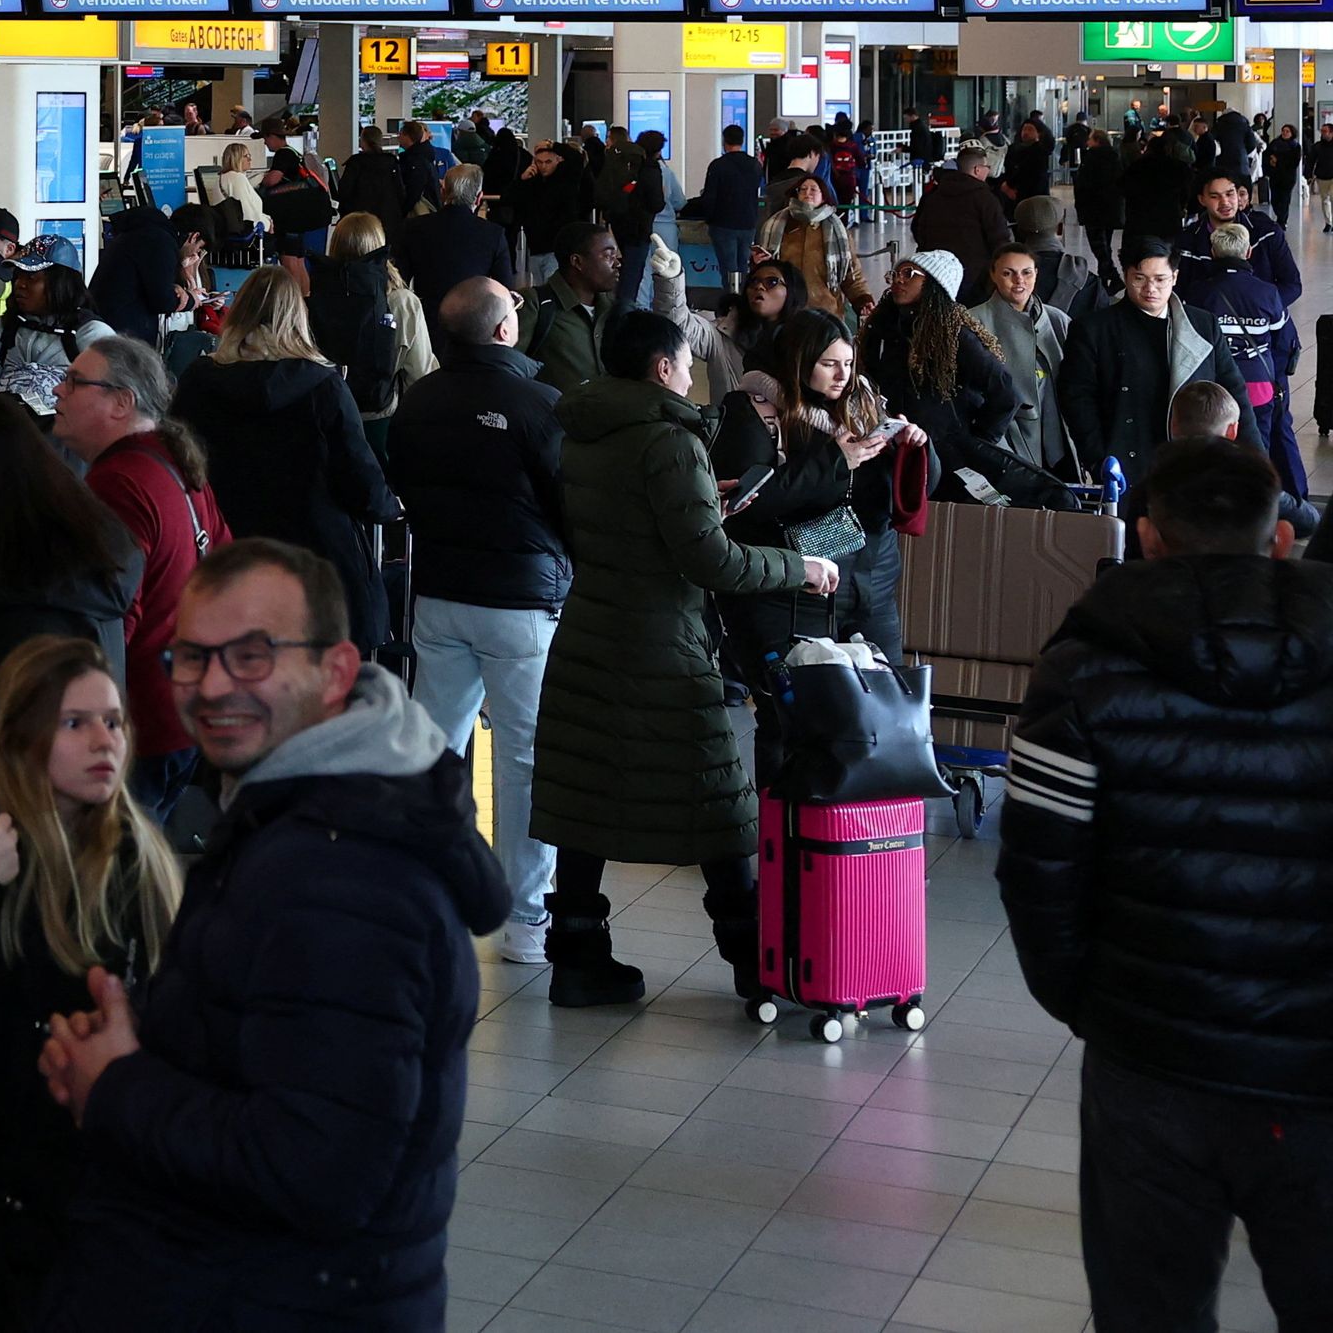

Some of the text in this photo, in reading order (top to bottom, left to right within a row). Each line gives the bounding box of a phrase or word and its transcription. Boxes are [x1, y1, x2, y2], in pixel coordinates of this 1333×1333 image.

[171, 29, 187, 43] Gates
[730, 29, 759, 42] 12-15
[371, 41, 399, 62] 12
[496, 46, 520, 65] 11
